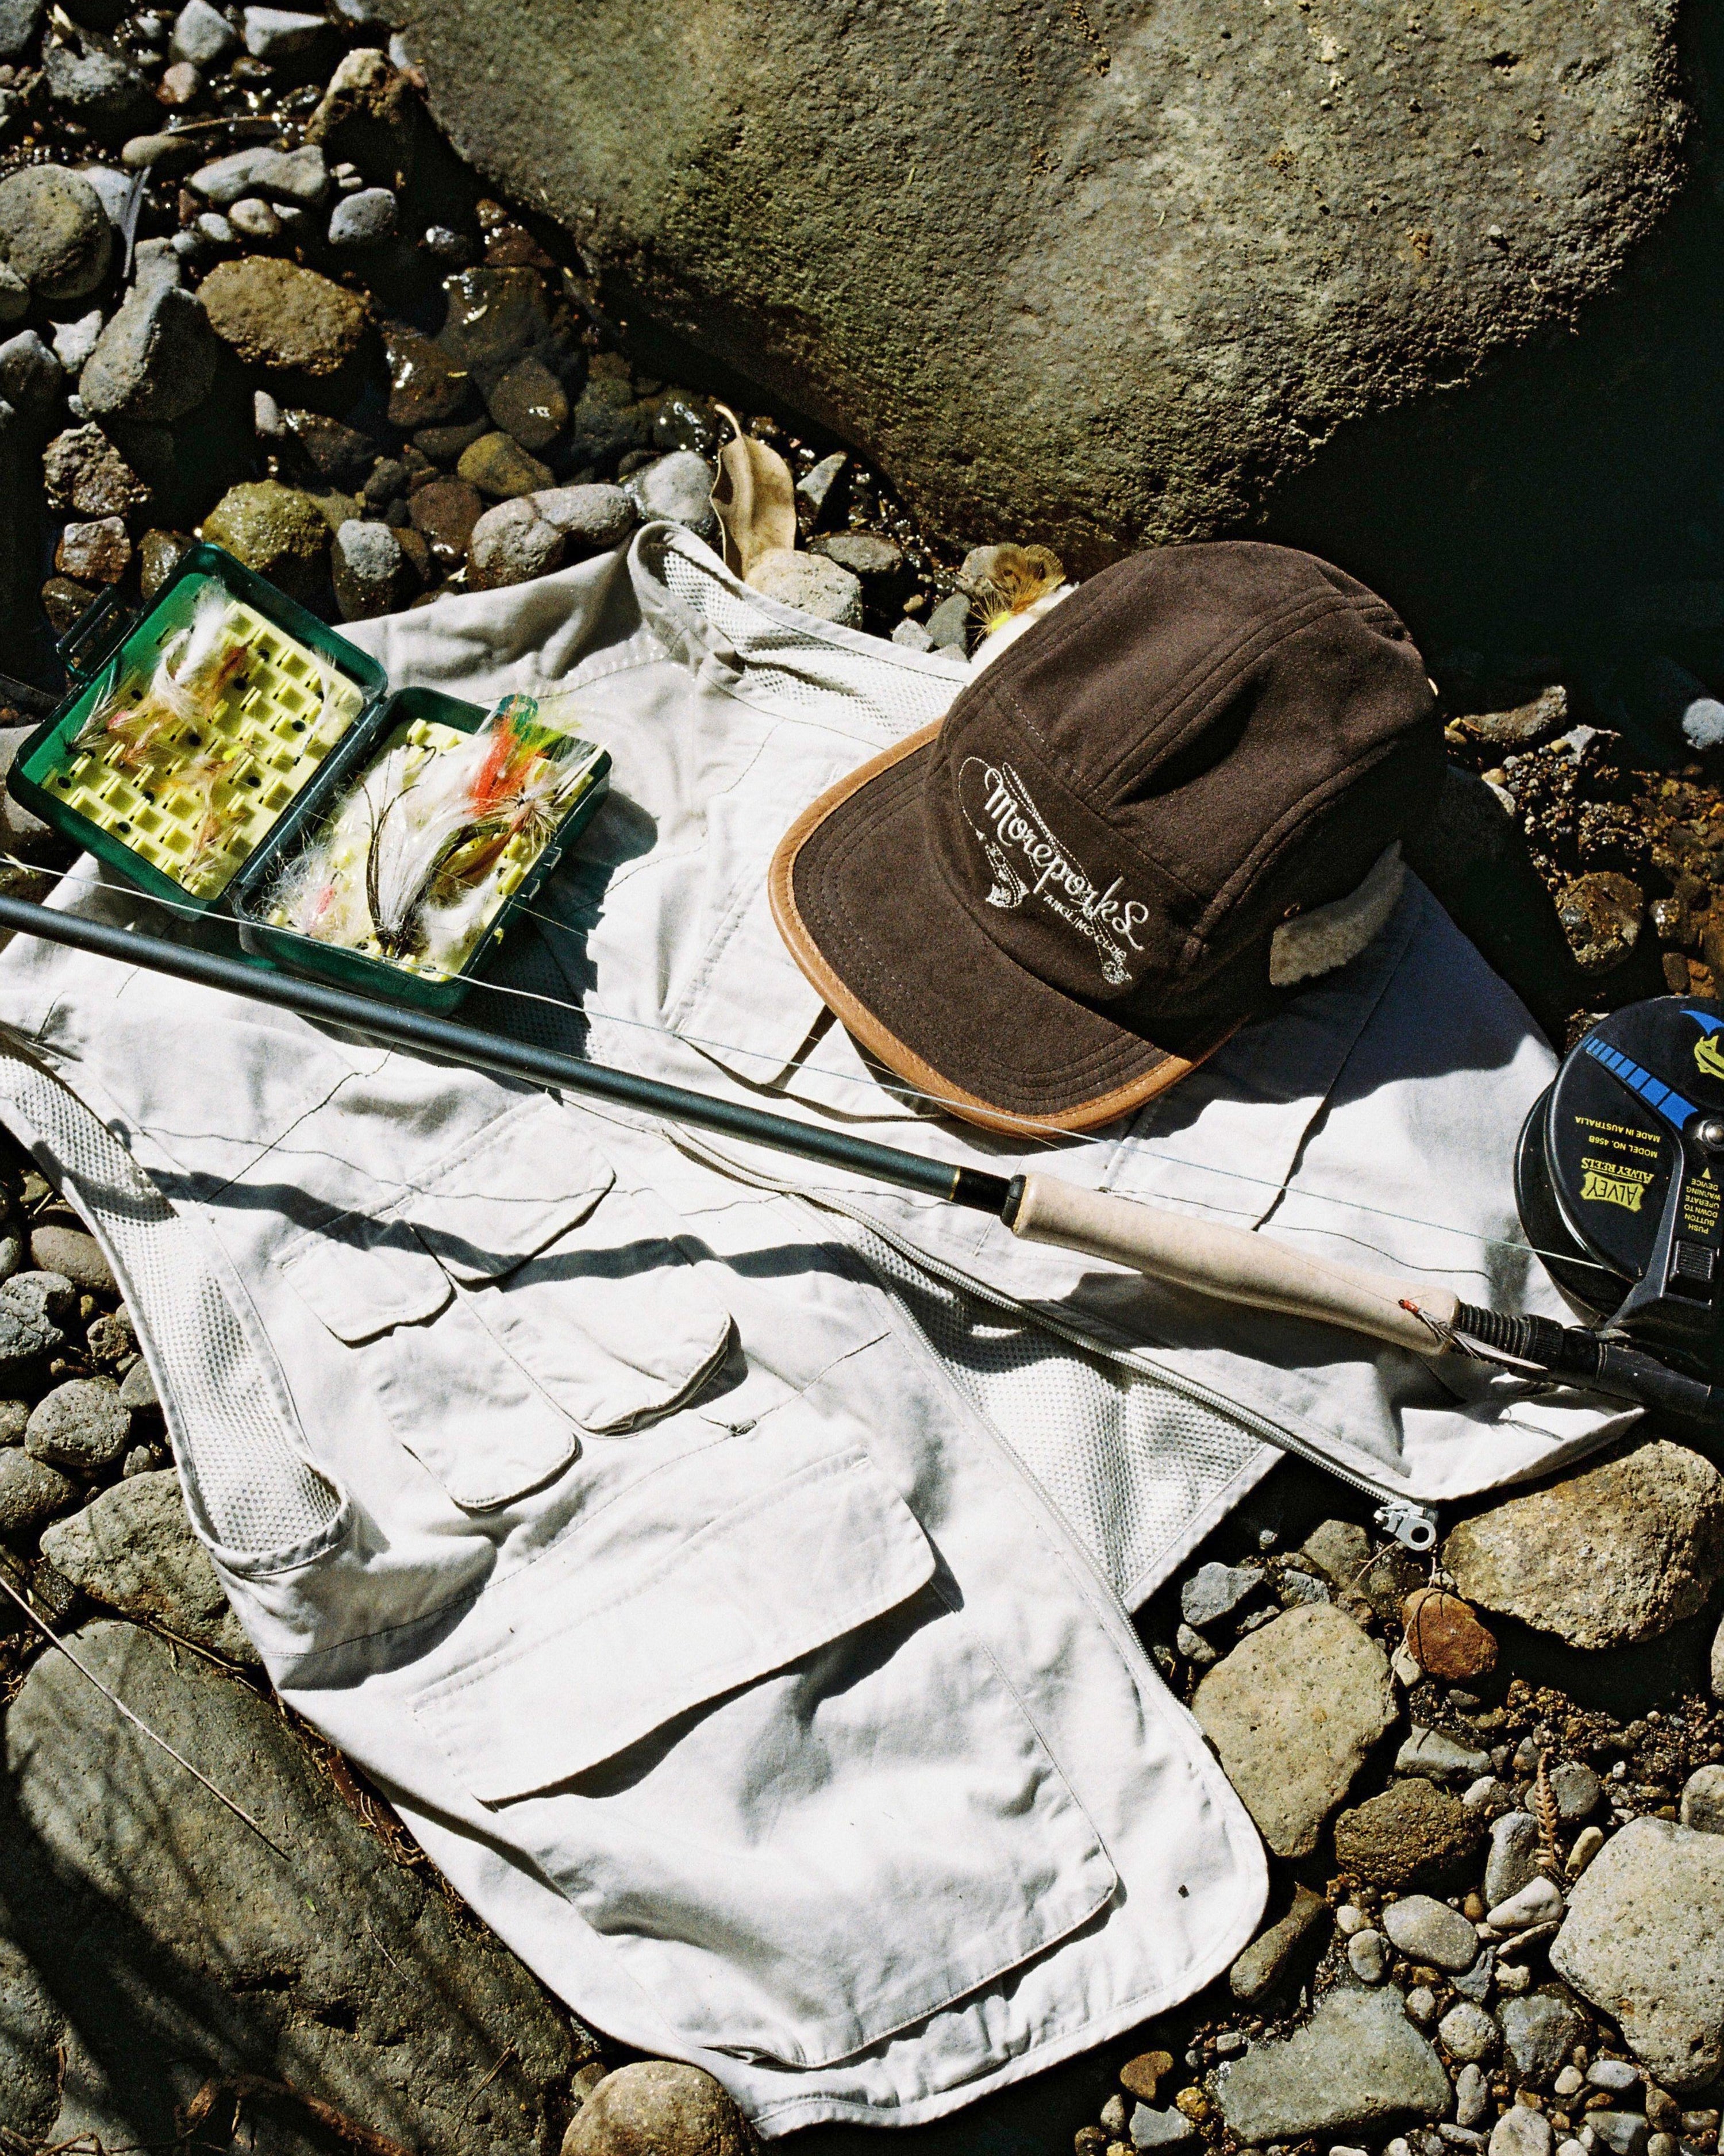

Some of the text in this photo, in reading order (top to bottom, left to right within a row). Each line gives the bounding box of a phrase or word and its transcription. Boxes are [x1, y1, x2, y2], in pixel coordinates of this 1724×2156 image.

[1043, 895, 1095, 936] ANGLING
[1575, 1116, 1660, 1143] MADE IN AUSTRALIA
[1588, 1135, 1658, 1158] MODEL NO. 456B
[1581, 1158, 1654, 1184] ALVEY REELS
[1587, 1177, 1638, 1206] ALVEY
[1691, 1178, 1718, 1191] DEVICE
[1684, 1213, 1715, 1227] BUTTON
[1695, 1207, 1718, 1218] DOWN
[1688, 1224, 1708, 1234] PUSH
